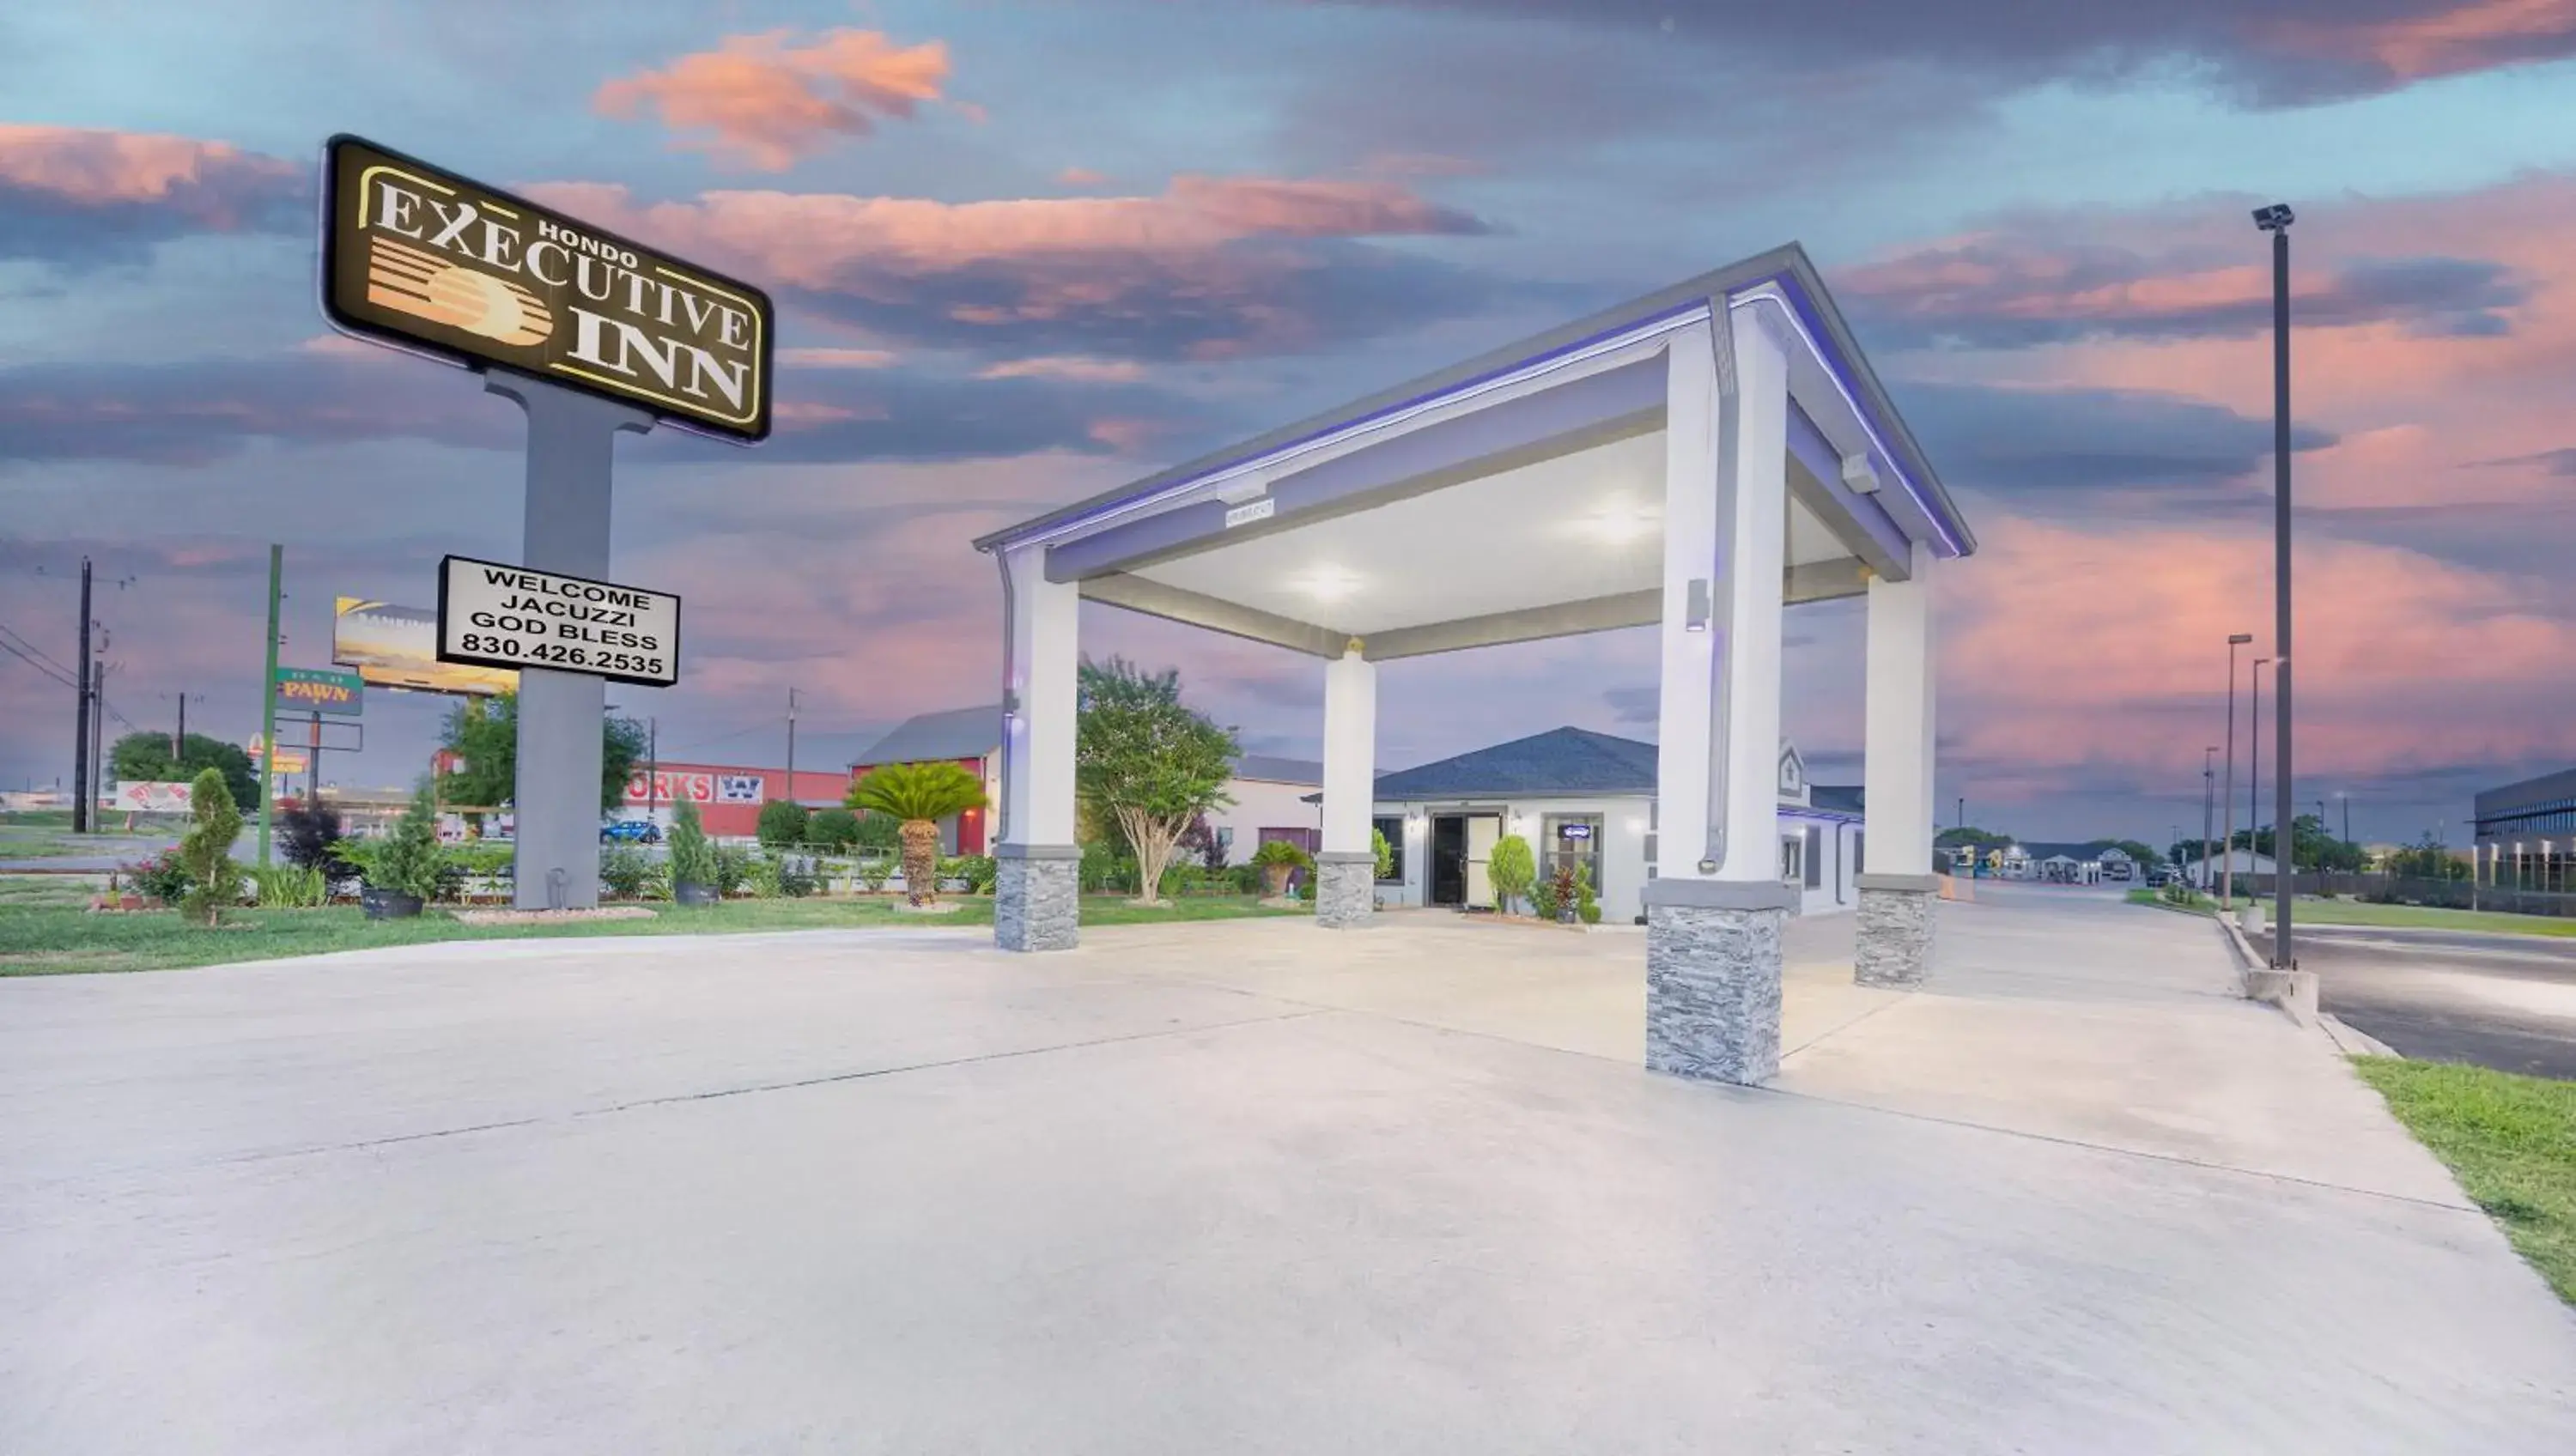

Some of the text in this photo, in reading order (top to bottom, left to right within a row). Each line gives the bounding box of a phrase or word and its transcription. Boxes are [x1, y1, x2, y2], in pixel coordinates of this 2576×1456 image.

[538, 220, 638, 270] HONDO
[374, 181, 750, 351] EXECUTIVE
[567, 305, 750, 410] INN
[484, 569, 651, 610] WELCOME
[471, 612, 659, 651] GOD BLESS
[501, 596, 635, 627] JACUZZI
[461, 634, 663, 674] 830.426.2535
[284, 682, 349, 701] PAWN
